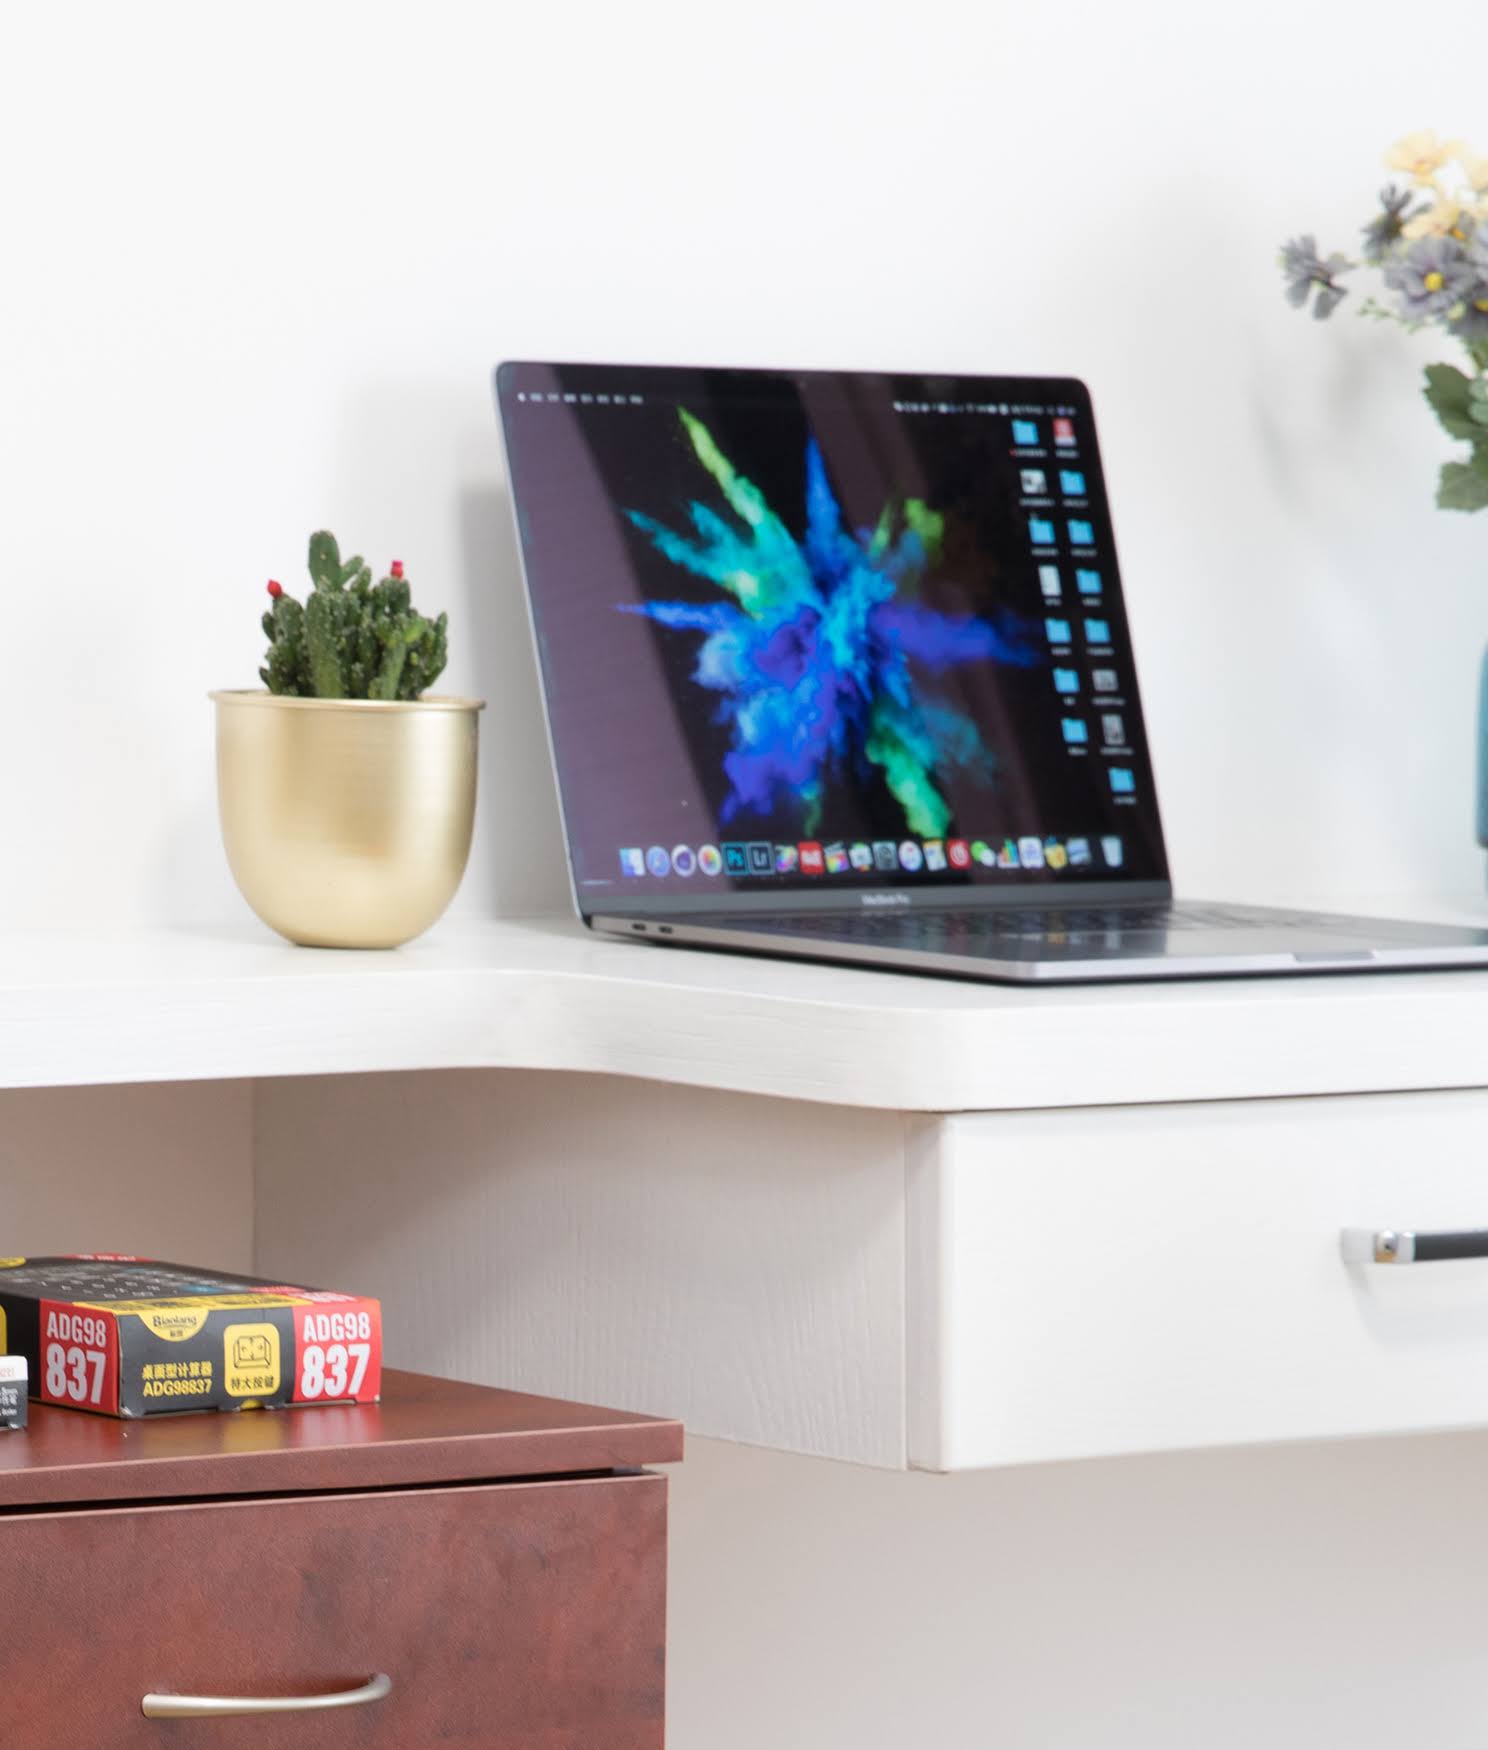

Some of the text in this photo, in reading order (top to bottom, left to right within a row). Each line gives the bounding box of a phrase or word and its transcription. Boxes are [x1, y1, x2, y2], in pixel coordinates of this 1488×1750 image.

[47, 1311, 106, 1348] ADG98
[303, 1311, 372, 1343] ADG98
[46, 1342, 107, 1404] 837
[142, 1361, 212, 1381] 桌面型计算器
[231, 1376, 274, 1391] 特大按键
[301, 1343, 371, 1398] 837
[143, 1378, 212, 1397] ADG98837
